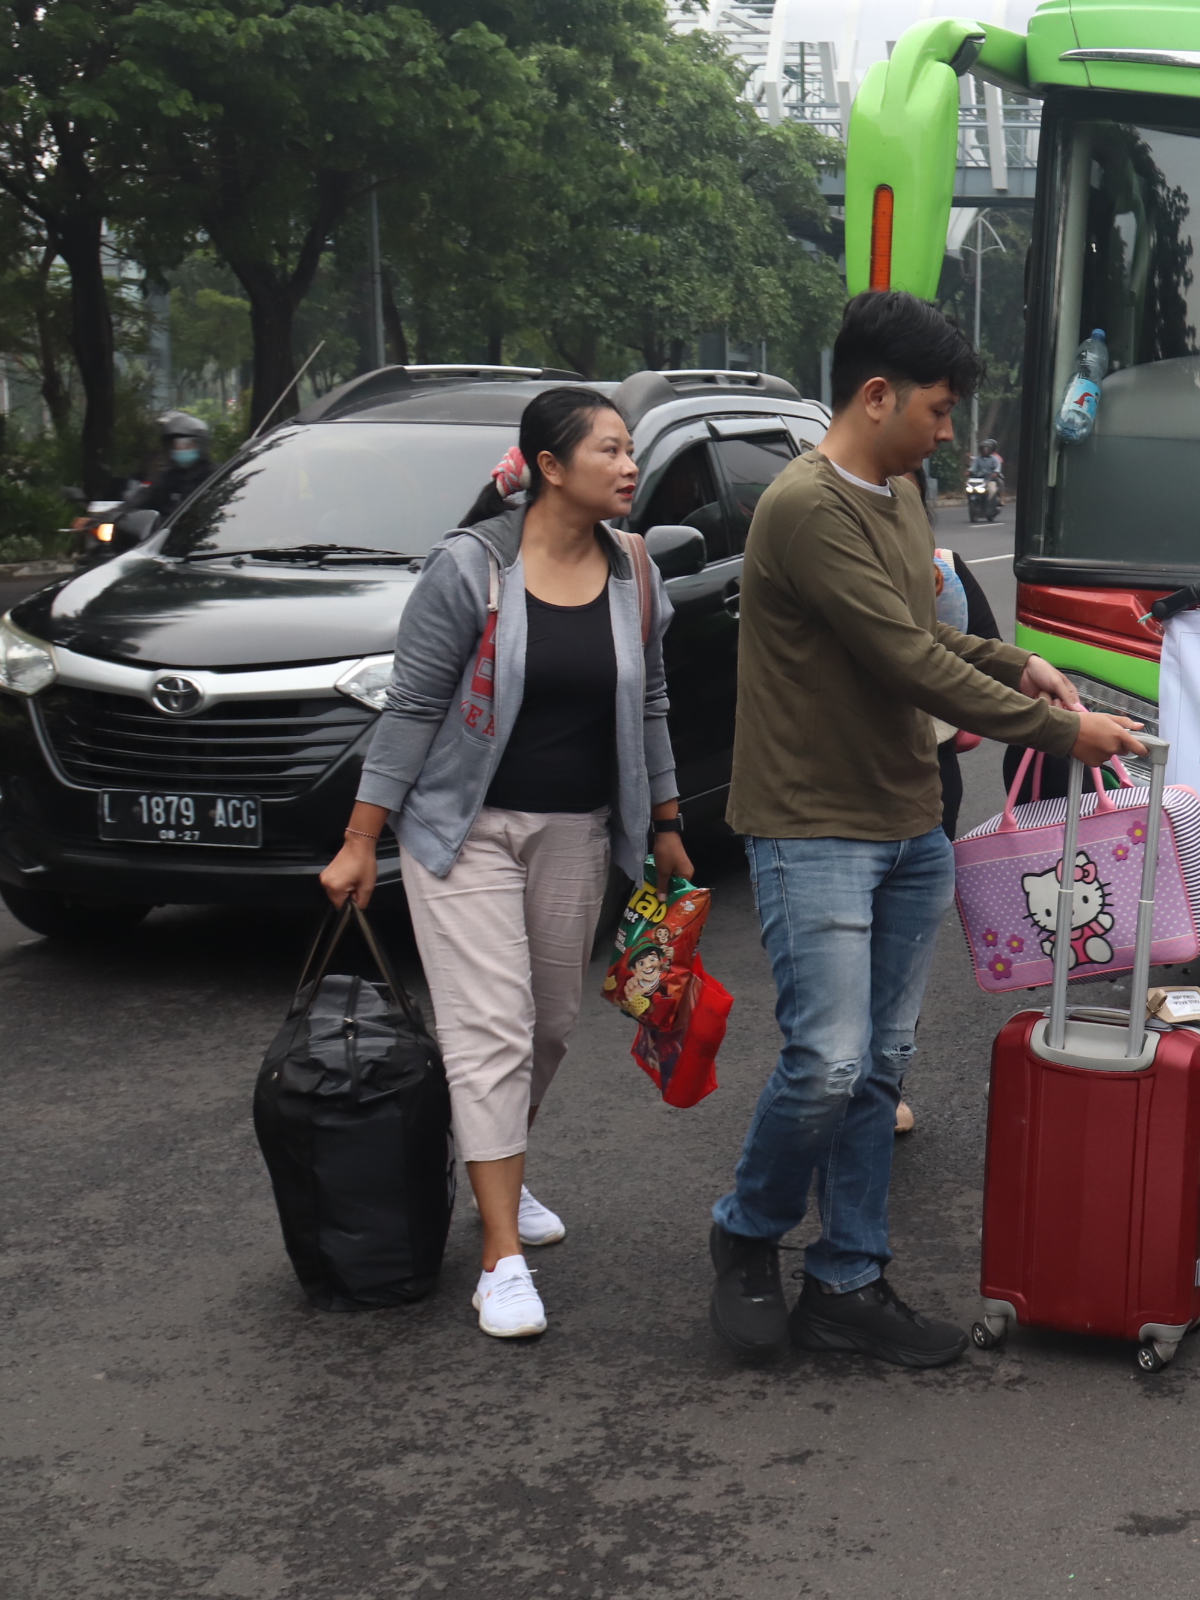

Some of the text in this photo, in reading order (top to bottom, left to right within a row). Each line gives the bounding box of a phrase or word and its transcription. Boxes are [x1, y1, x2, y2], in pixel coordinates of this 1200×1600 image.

[103, 794, 257, 828] L 1879 ACG
